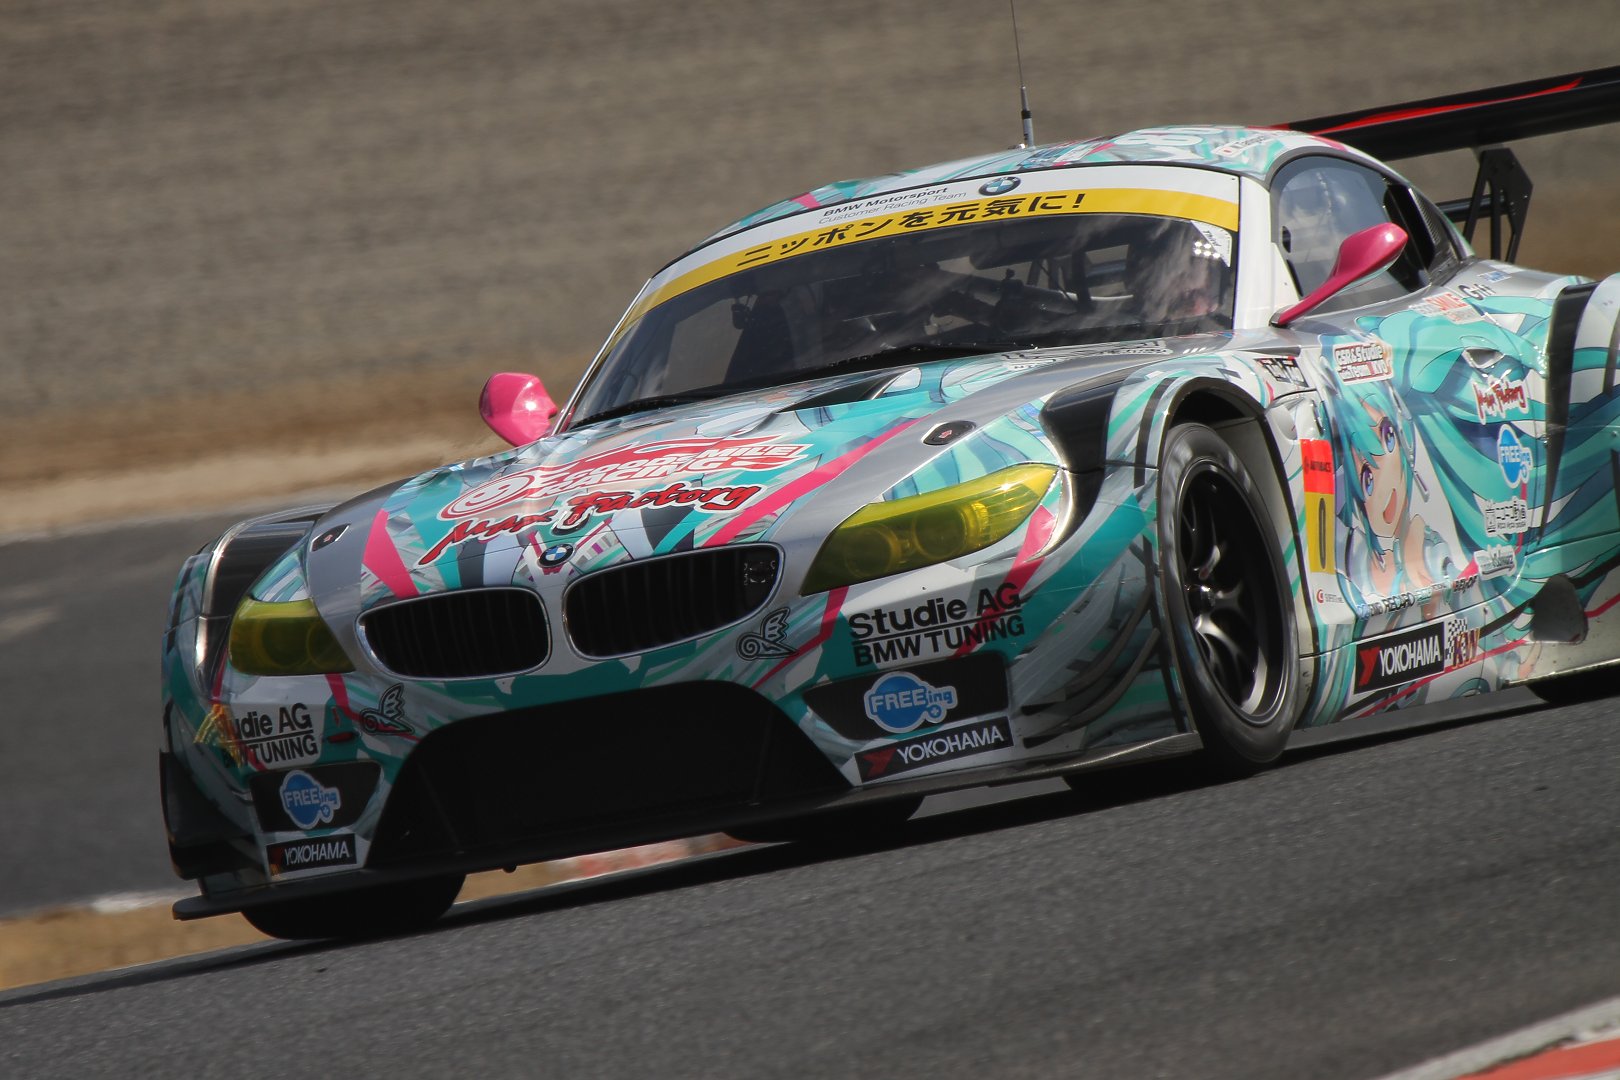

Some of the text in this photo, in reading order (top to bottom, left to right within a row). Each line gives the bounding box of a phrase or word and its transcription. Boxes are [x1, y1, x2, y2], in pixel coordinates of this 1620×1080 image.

[818, 191, 967, 225] Customer Racing Team
[824, 187, 948, 217] BMW Motorsport
[737, 193, 1086, 267] ニッポンを元気に!
[531, 457, 729, 498] RACING
[563, 482, 763, 527] Factory
[849, 582, 1024, 639] Studie AG
[851, 614, 1025, 668] BMW TUNING
[1380, 635, 1441, 677] YOKOHAMA
[278, 702, 314, 734] AG
[870, 687, 955, 715] FREEing
[247, 734, 319, 765] TUNING
[897, 725, 1005, 765] YOKOHAMA
[284, 788, 339, 808] FREEing
[285, 840, 350, 865] YOKOHAMA
